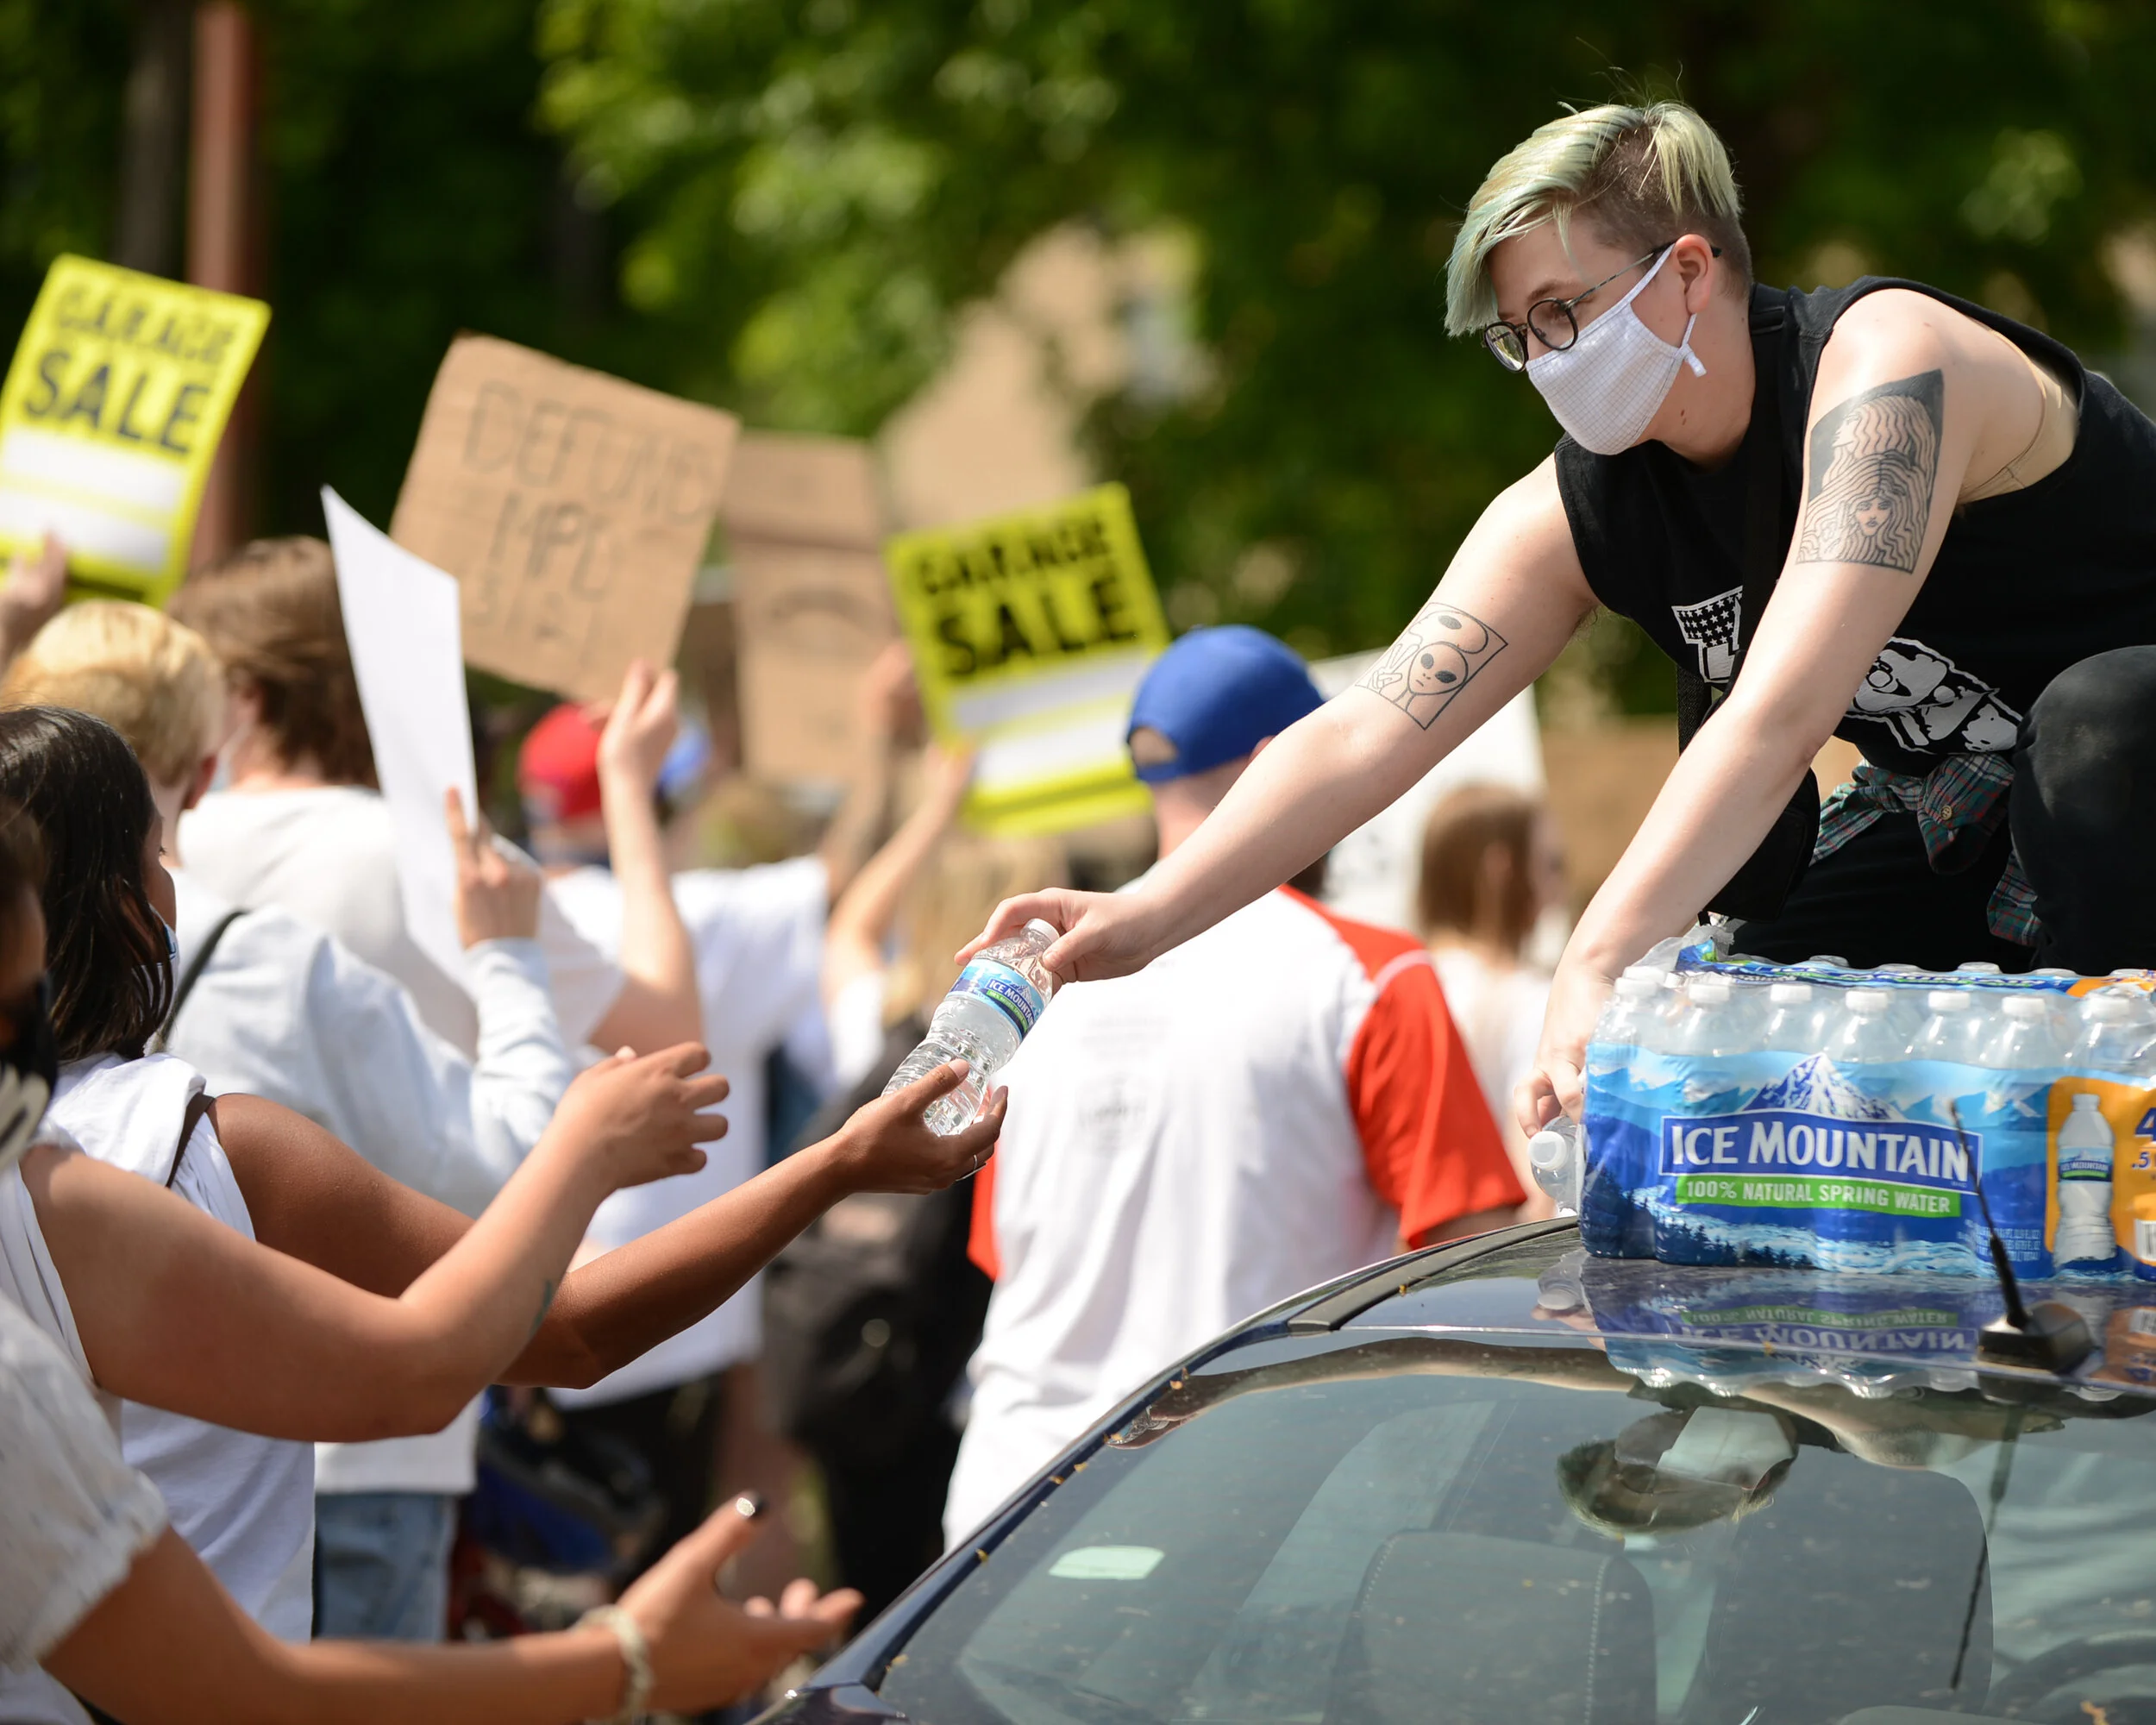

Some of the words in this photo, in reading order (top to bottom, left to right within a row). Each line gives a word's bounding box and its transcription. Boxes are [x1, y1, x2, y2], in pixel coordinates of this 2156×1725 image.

[55, 281, 235, 367] GARAGE
[24, 347, 210, 457] SALE
[462, 377, 718, 528] DEFUND
[916, 516, 1112, 597] GARAGE
[935, 578, 1140, 678] SALE
[988, 979, 1006, 994] ICE
[1671, 1125, 1739, 1166] ICE
[1748, 1121, 1970, 1182] MOUNTAIN
[1686, 1180, 1737, 1200] 100%
[1743, 1183, 1814, 1202] NATURAL
[1819, 1184, 1889, 1208] SPRING
[1895, 1192, 1951, 1214] WATER
